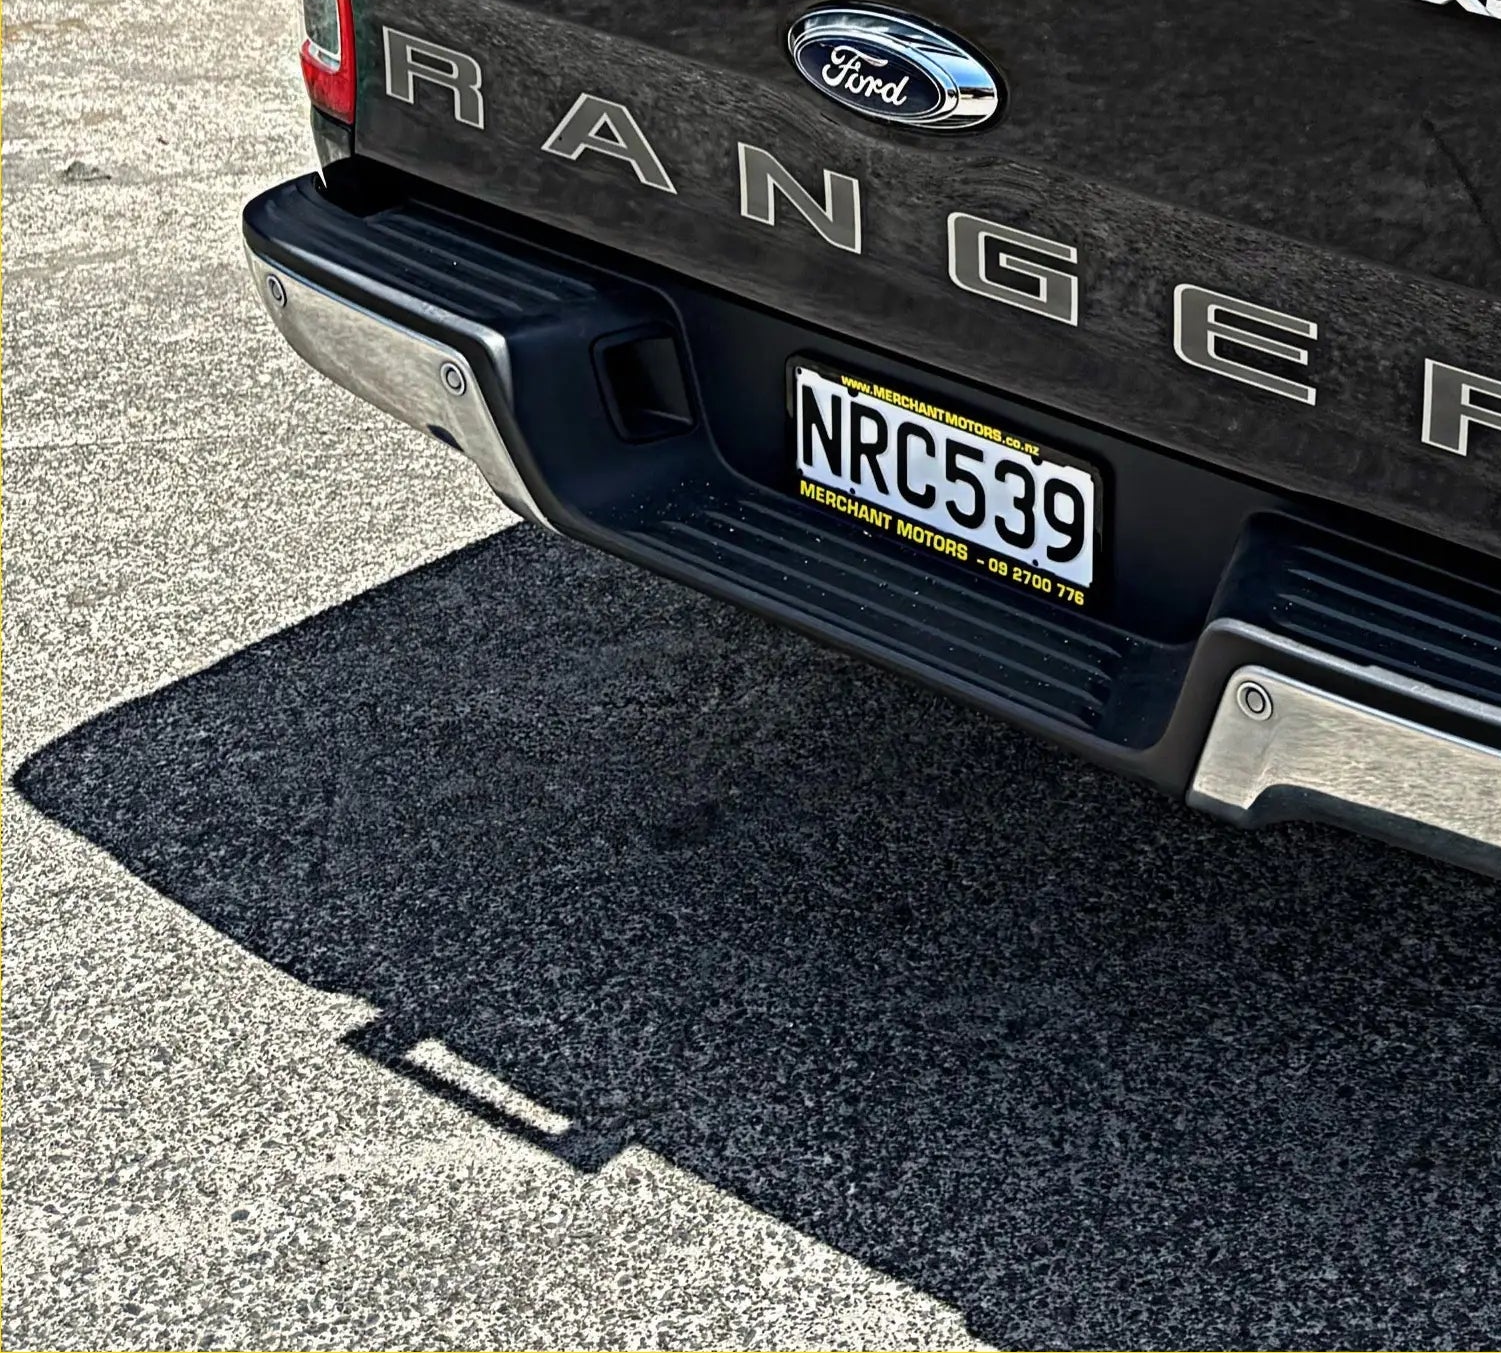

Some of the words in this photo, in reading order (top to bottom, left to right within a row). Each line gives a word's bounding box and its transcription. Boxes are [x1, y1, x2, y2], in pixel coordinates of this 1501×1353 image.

[821, 45, 910, 106] Ford
[841, 375, 1040, 456] www.MERCHANTMOTORS.co.nz
[801, 384, 1085, 563] NRC539
[800, 480, 893, 531] MERCHANT
[896, 519, 969, 561] MOTORS
[988, 556, 1008, 577] 09
[1012, 565, 1051, 593] 2700
[1056, 582, 1085, 606] 776
